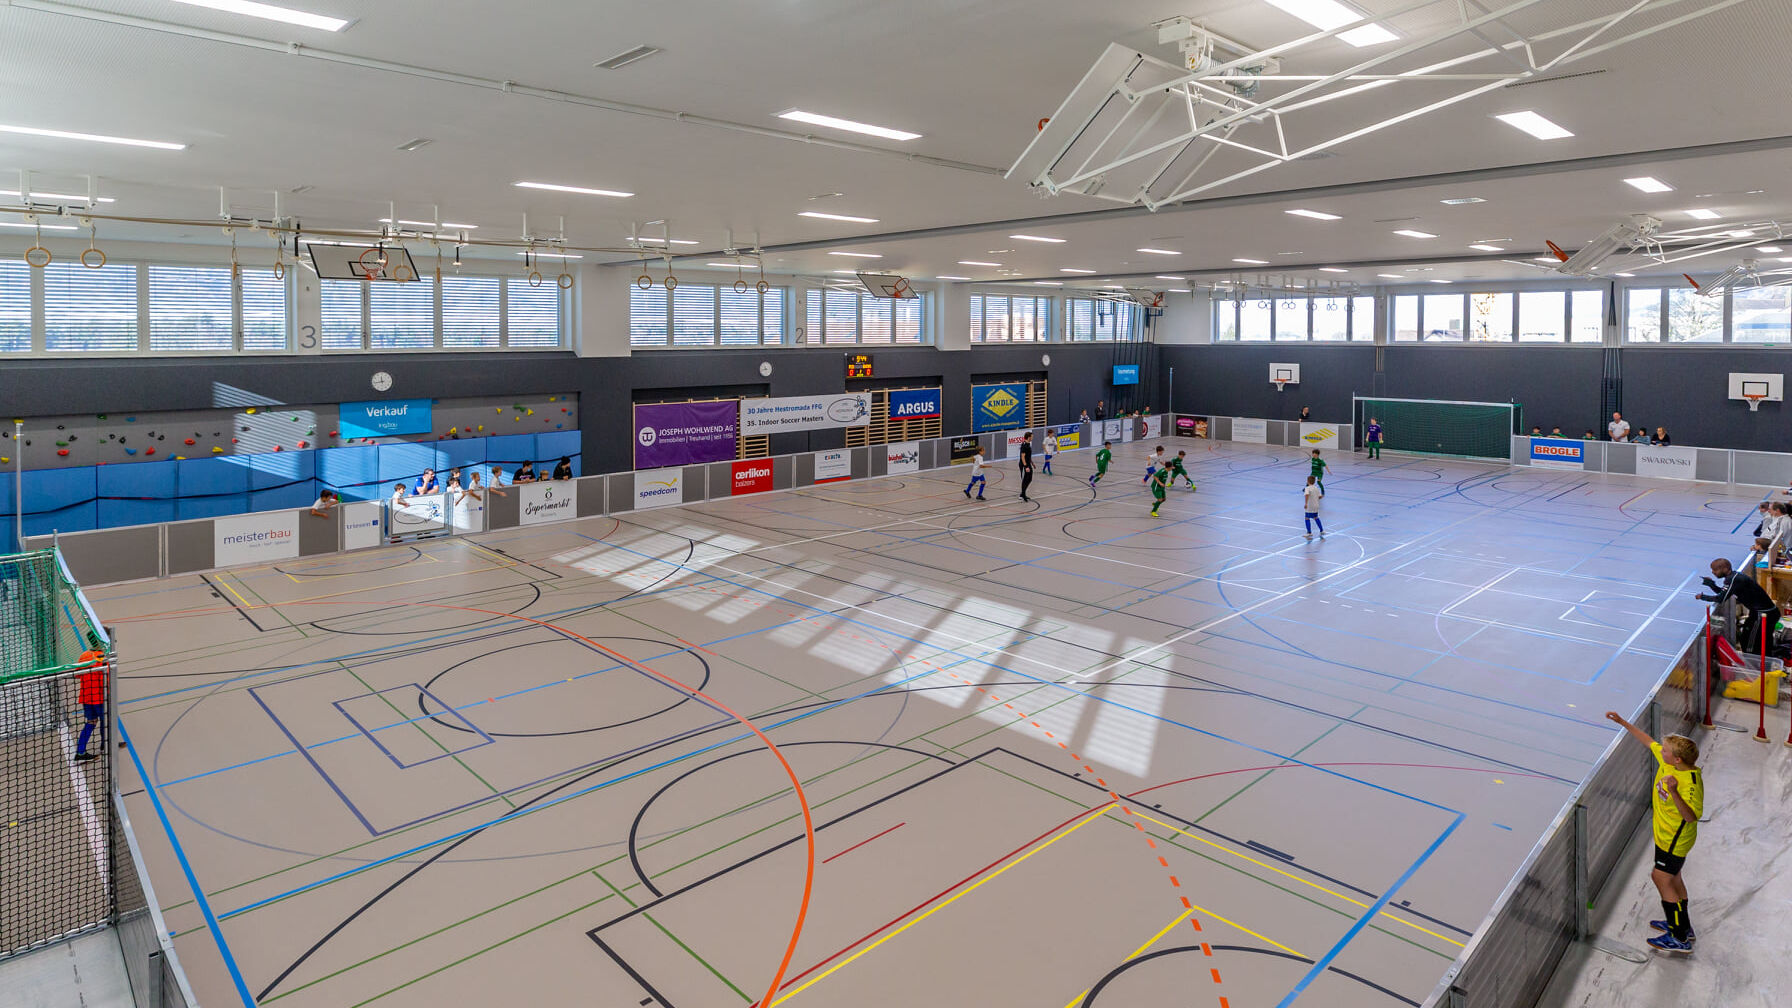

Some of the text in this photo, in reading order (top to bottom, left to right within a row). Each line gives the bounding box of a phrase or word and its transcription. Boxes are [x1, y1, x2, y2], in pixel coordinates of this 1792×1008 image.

[301, 325, 317, 349] 3
[795, 327, 804, 344] 2
[897, 401, 934, 415] ARGUS
[987, 399, 1014, 408] KINDLE
[366, 404, 409, 417] Verkauf
[780, 417, 801, 425] Soccer
[658, 424, 734, 436] JOSEPH WOHLWEND AG
[1534, 445, 1580, 457] BROGLE
[1641, 456, 1691, 466] SWAROVSKI
[639, 487, 678, 499] speedcom
[525, 498, 570, 515] Supermarkt
[223, 529, 292, 545] meisterbau
